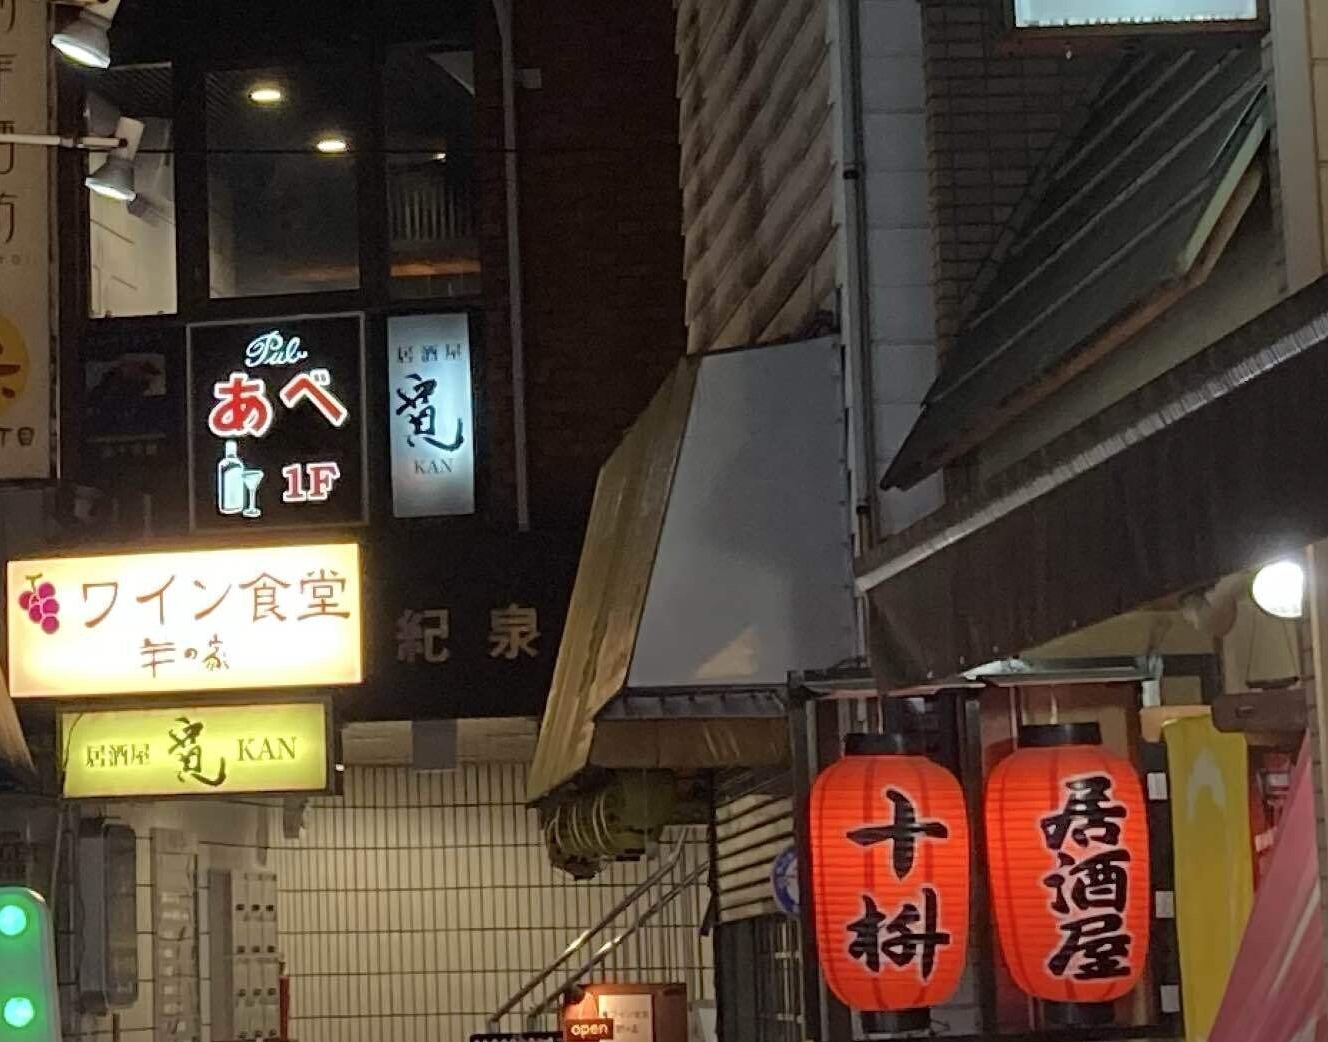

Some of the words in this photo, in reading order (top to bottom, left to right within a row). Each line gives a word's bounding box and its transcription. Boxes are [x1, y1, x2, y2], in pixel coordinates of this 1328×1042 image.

[244, 330, 309, 367] Pub
[397, 343, 464, 364] 居酒屋
[208, 368, 348, 438] あべ
[282, 461, 340, 502] 1F
[414, 459, 454, 474] KAN
[82, 568, 351, 629] ワイン食堂
[396, 605, 541, 665] 紀泉
[86, 742, 151, 768] 居酒屋
[237, 735, 298, 763] KAN
[1040, 775, 1132, 981] 居酒屋
[571, 1022, 609, 1038] open
